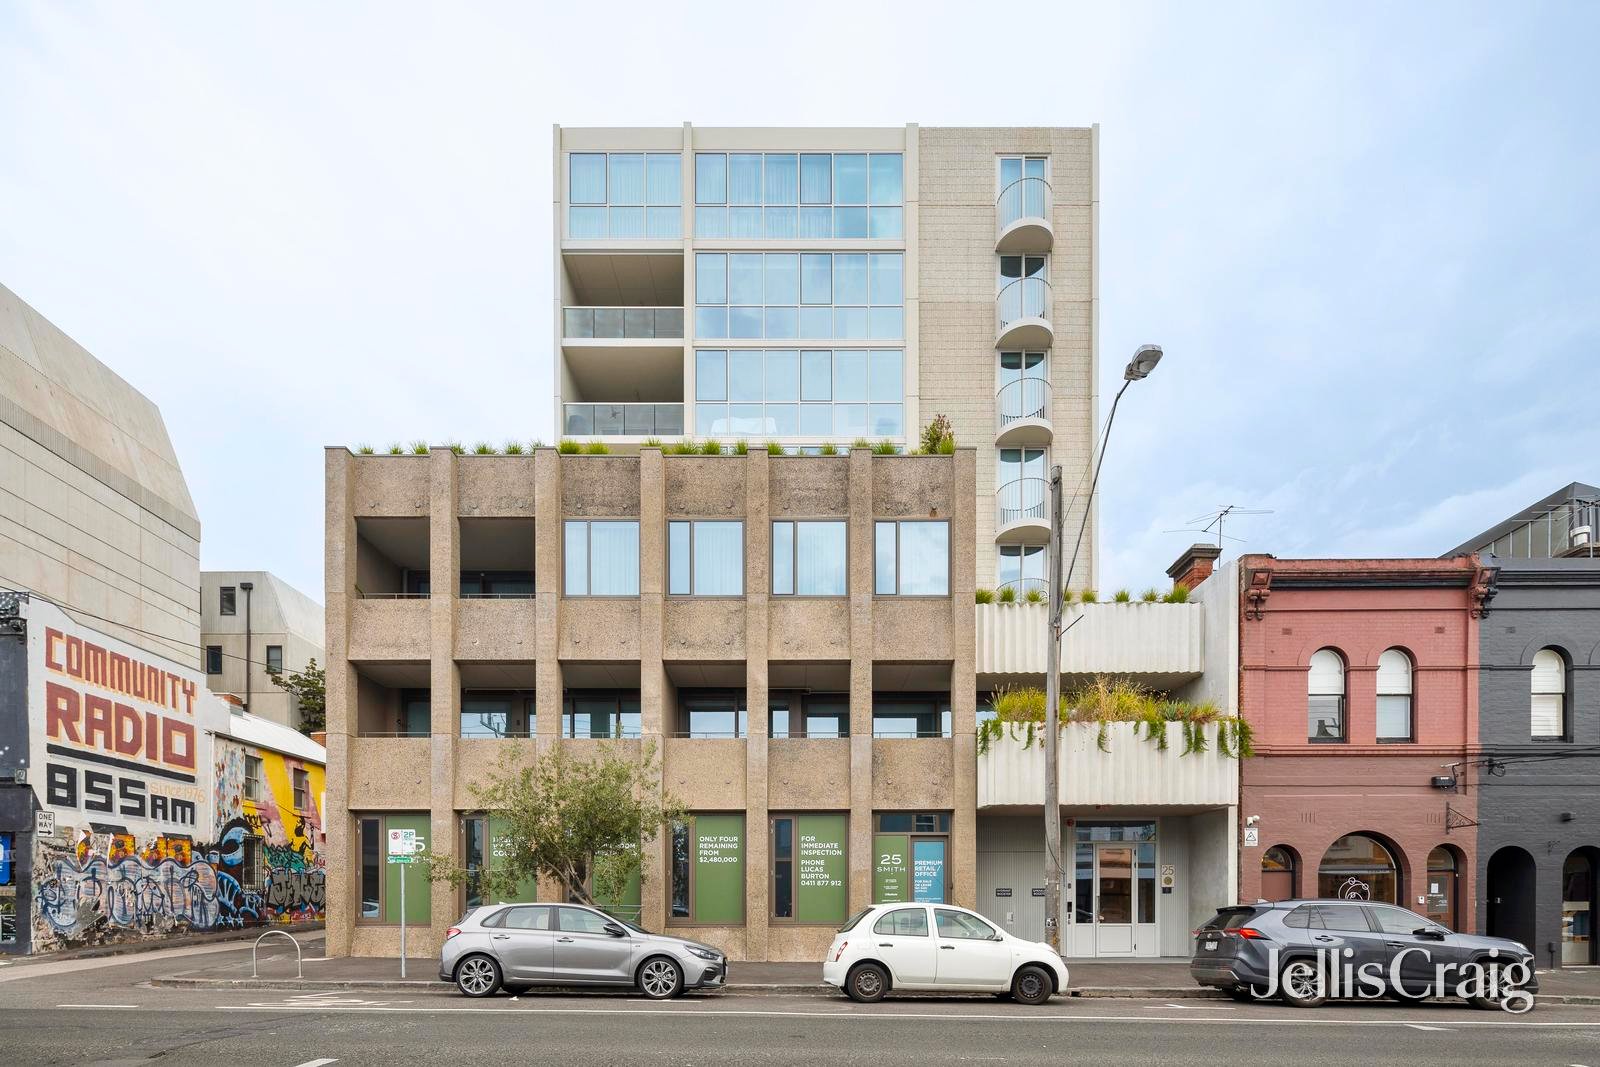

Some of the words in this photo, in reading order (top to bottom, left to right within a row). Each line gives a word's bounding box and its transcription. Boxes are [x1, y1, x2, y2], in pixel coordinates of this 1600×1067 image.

[45, 626, 197, 716] COMMUNITY
[46, 680, 197, 774] RADIO
[38, 813, 53, 821] ONE
[38, 821, 53, 829] WAY
[403, 831, 415, 839] 2P
[699, 856, 738, 864] $2,480,000
[881, 854, 902, 864] 25
[1161, 865, 1175, 876] 25
